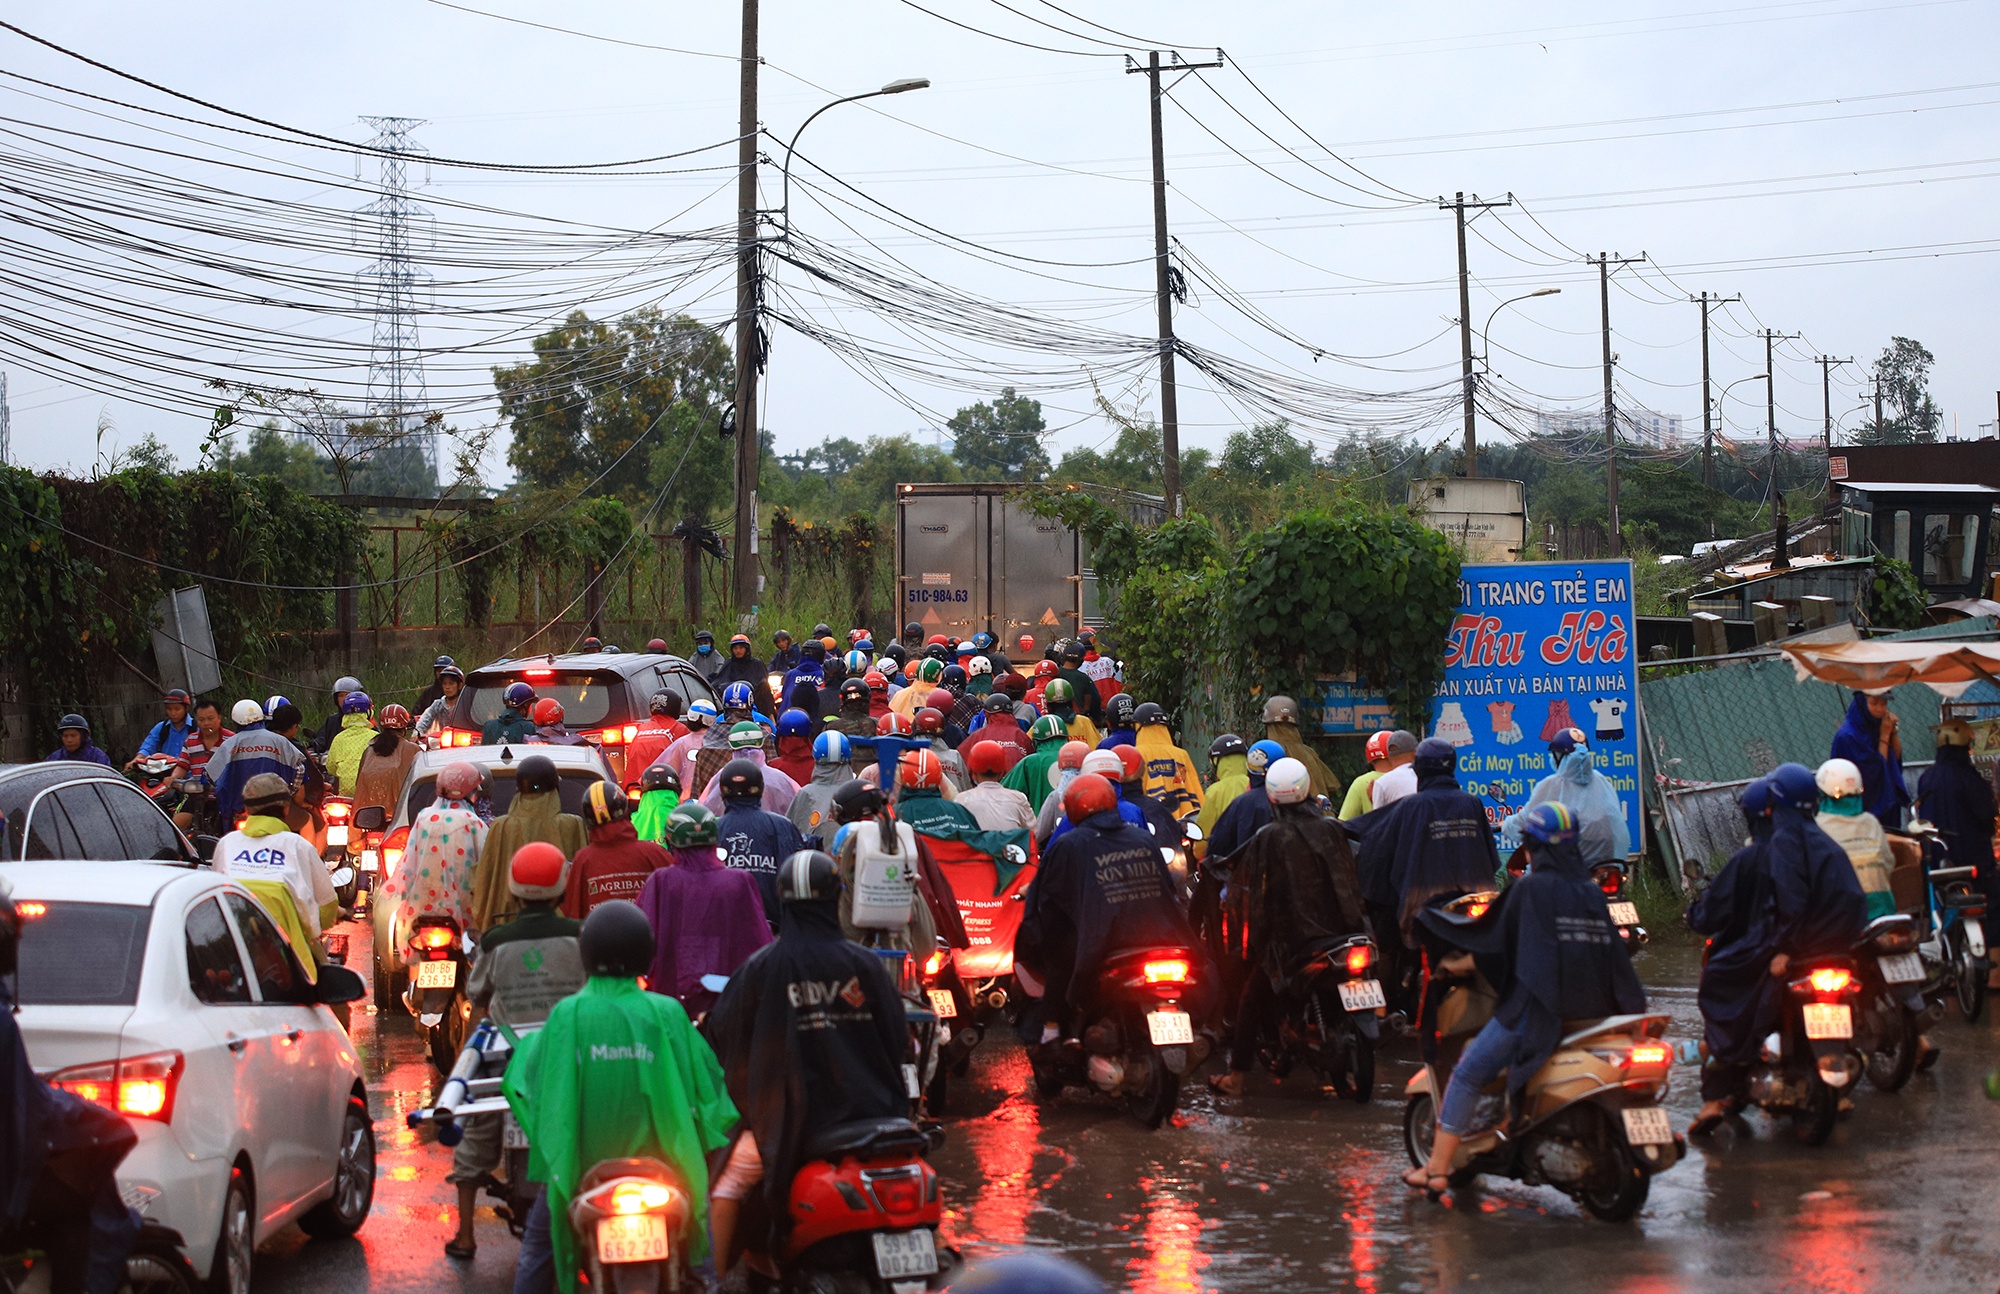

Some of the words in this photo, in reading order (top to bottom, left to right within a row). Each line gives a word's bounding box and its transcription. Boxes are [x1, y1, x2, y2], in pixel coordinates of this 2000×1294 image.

[908, 589, 968, 603] 51C-984.63
[1477, 580, 1546, 607] TRANG
[1551, 570, 1588, 605] TRẺ
[1595, 578, 1627, 603] EM
[1444, 611, 1528, 669] Thu
[1539, 608, 1629, 666] Hà
[1464, 671, 1504, 697] XUẤT
[1508, 671, 1528, 695] VÀ
[1532, 669, 1565, 695] BÁN
[1567, 674, 1592, 696] TẠI
[1595, 669, 1628, 692] NHÀ
[384, 717, 397, 725] LEO
[236, 744, 281, 756] HONDA
[1459, 752, 1483, 772] Cắt
[1486, 755, 1514, 775] May
[1517, 752, 1545, 771] Thời
[1613, 751, 1635, 767] Em
[1467, 780, 1488, 797] Đo
[234, 848, 286, 866] ACB
[726, 854, 778, 869] DENTIAL
[975, 901, 1003, 909] NHANH
[964, 917, 992, 925] EXPRESS
[968, 936, 992, 945] 1088
